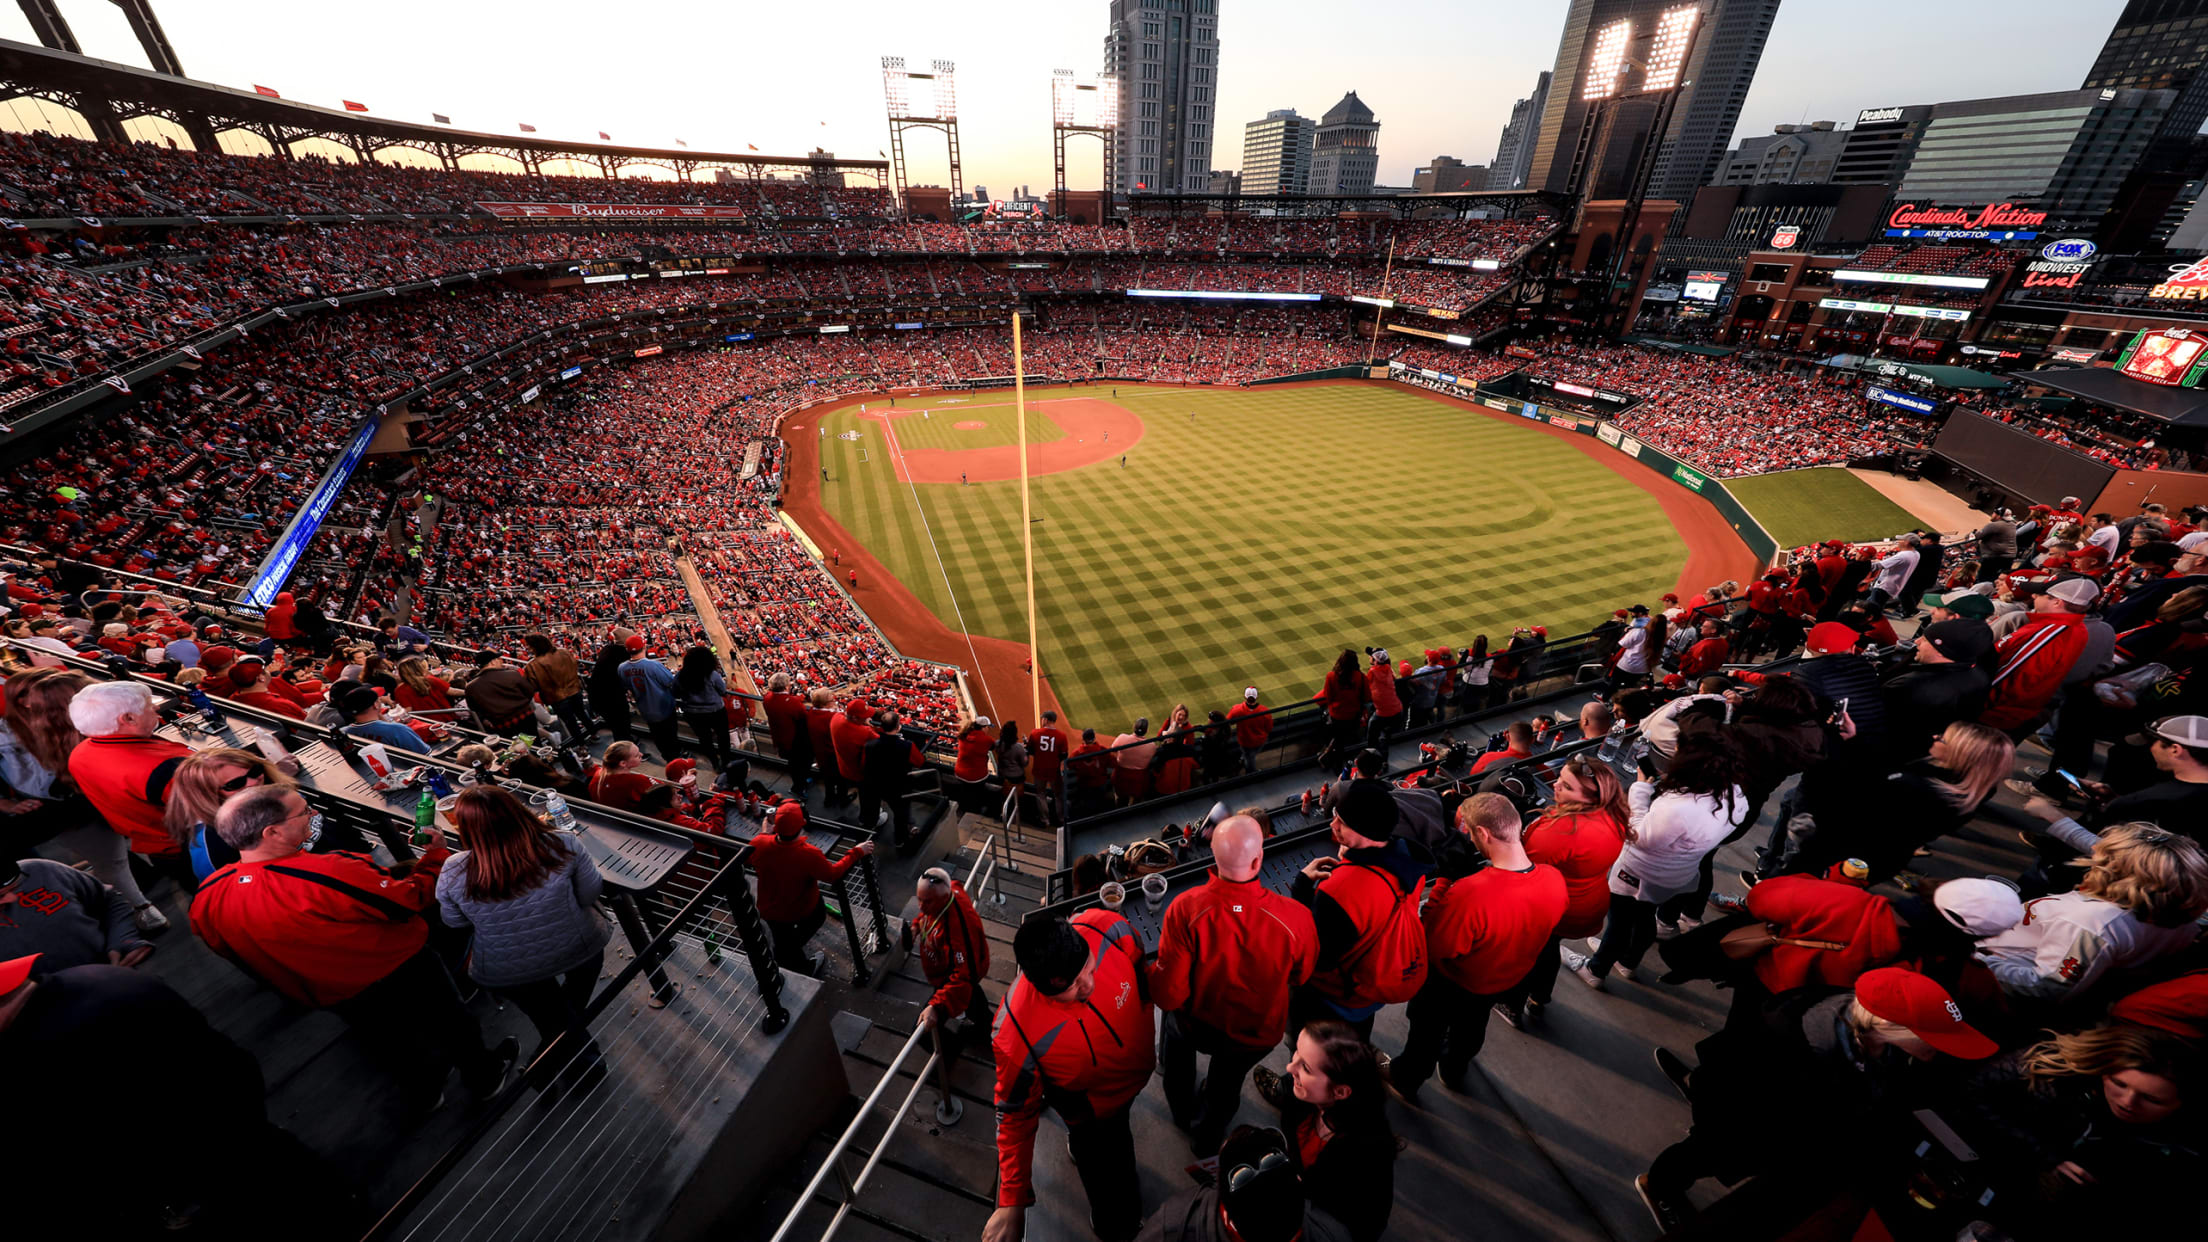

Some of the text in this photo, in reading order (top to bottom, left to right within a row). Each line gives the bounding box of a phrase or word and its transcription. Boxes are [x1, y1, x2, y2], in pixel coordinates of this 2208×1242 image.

[1860, 107, 1903, 122] Peabody
[558, 203, 666, 217] Budweiser
[1889, 202, 2047, 229] Cardinals Nation
[1775, 234, 1793, 245] 66
[1946, 230, 1989, 239] ROOFTOP
[2053, 243, 2086, 253] FOX
[2026, 261, 2092, 273] MIDWEST
[2023, 271, 2082, 288] Live!
[2152, 375, 2168, 385] DECK
[1039, 735, 1056, 752] 51
